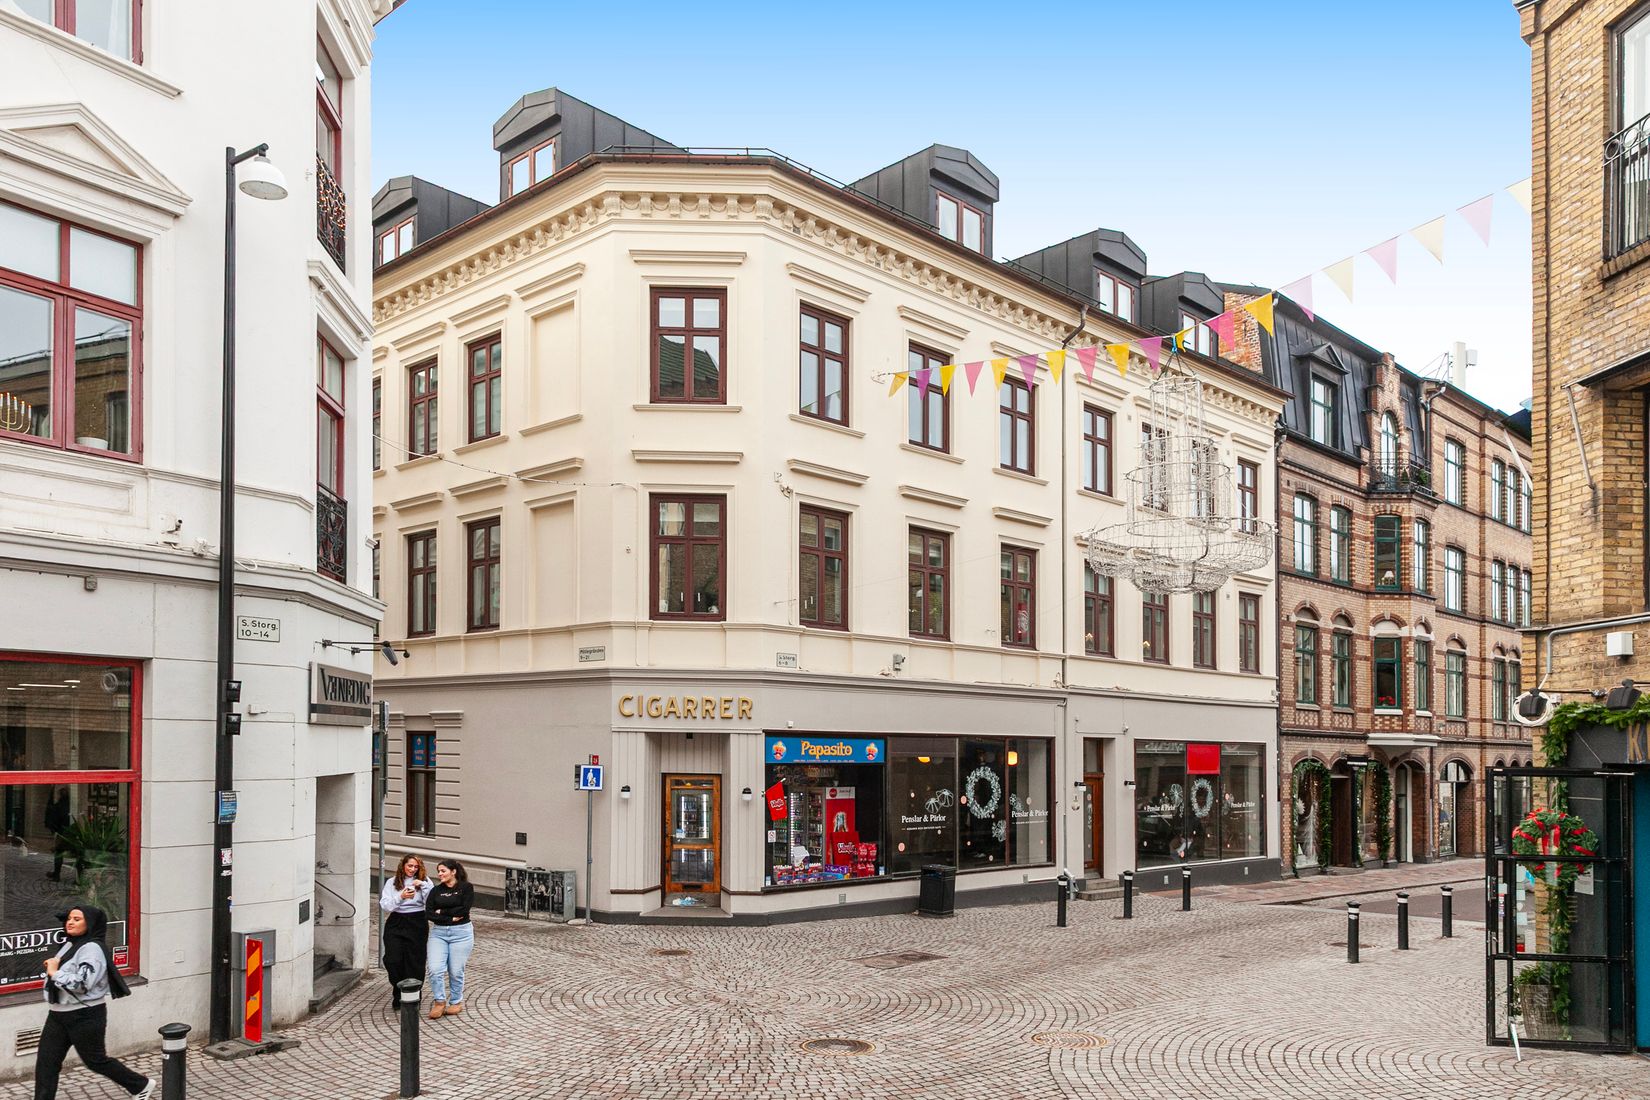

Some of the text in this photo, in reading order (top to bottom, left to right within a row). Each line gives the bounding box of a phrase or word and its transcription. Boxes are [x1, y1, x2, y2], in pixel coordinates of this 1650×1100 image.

[241, 619, 279, 631] S. Storg.
[619, 695, 753, 720] CIGARRER
[801, 740, 853, 759] Papasito
[901, 815, 922, 824] Penslar
[922, 814, 929, 823] &
